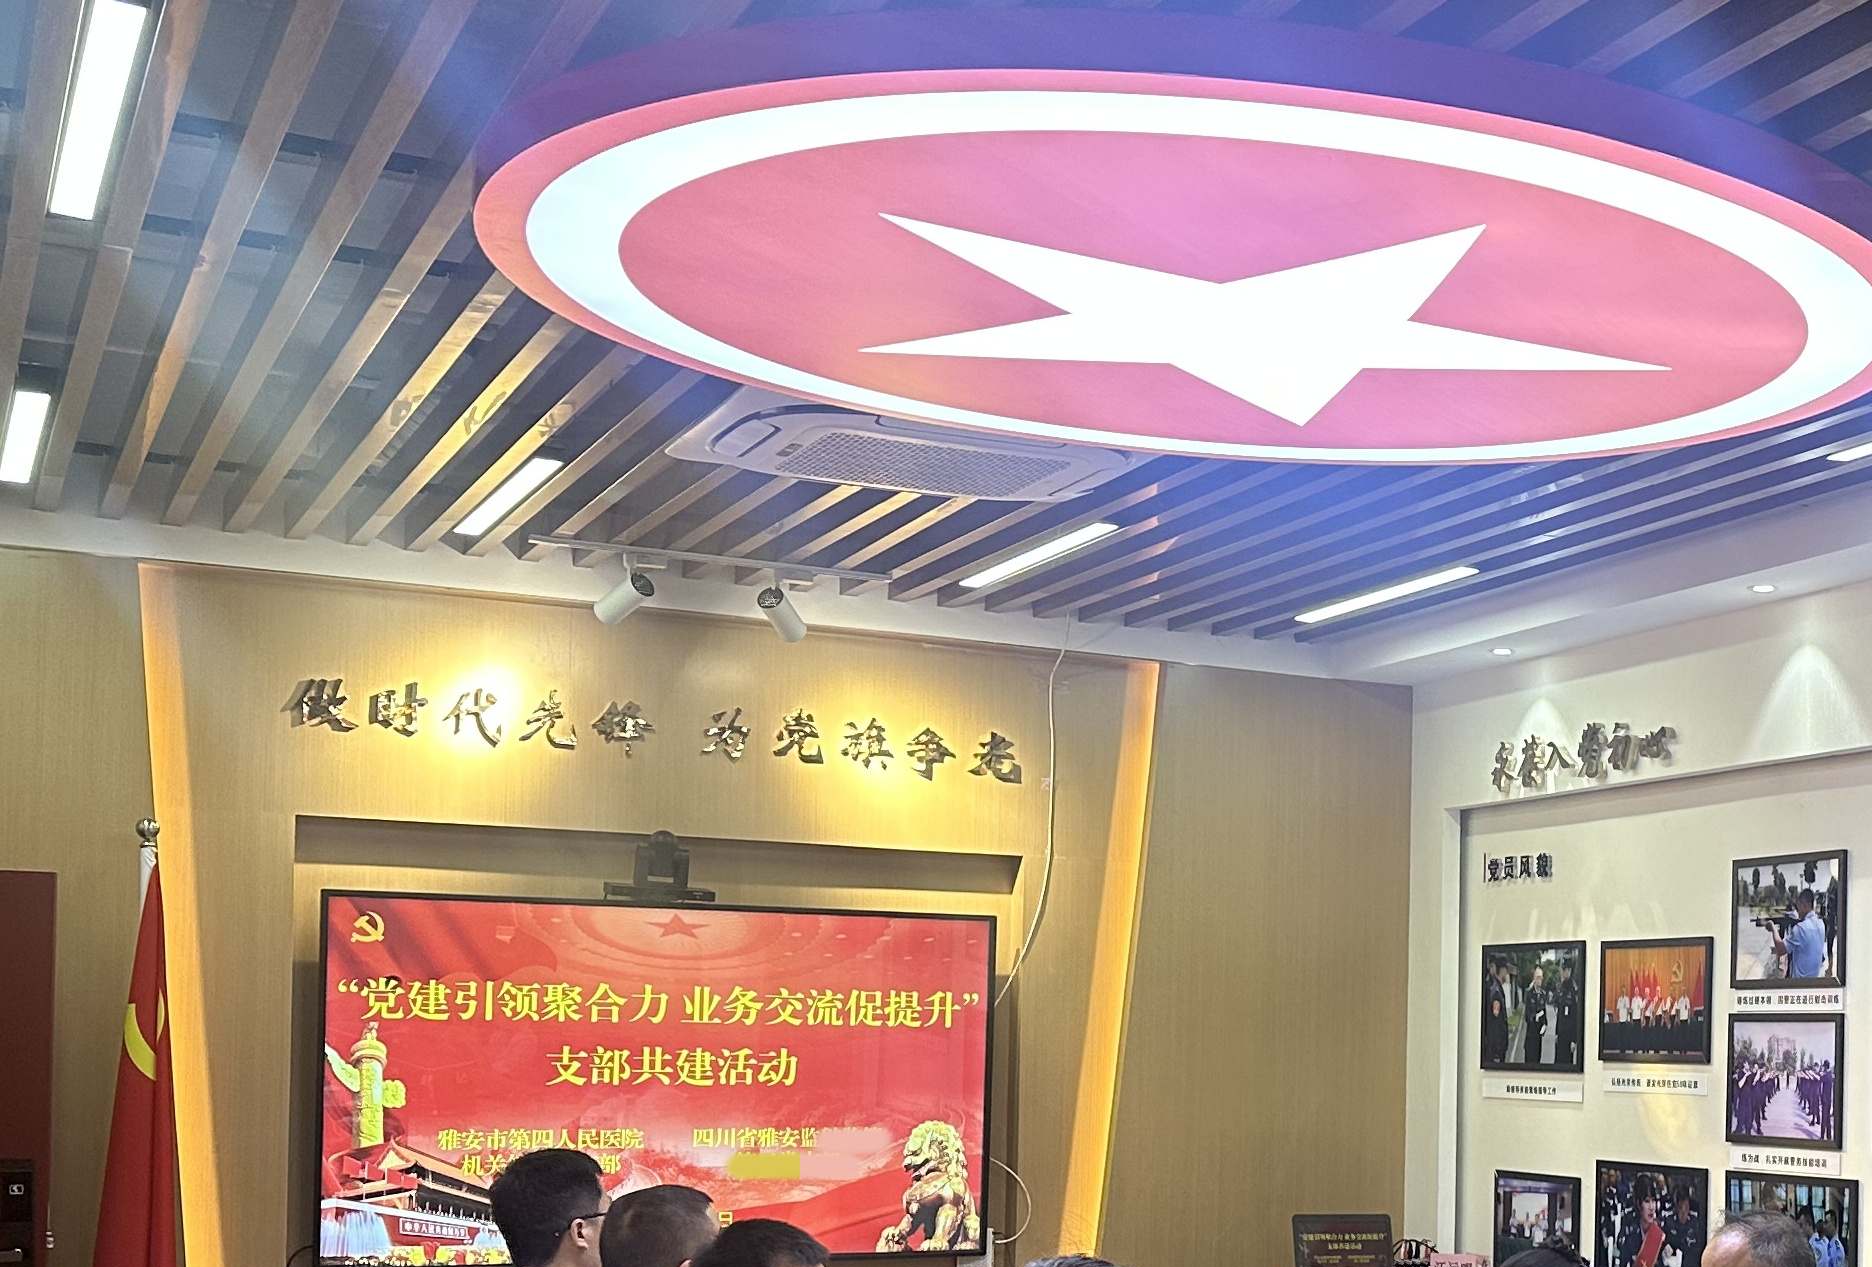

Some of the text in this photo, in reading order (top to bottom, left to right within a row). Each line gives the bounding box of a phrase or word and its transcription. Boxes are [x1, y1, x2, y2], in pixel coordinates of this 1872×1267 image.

[1487, 853, 1552, 883] 党员风貌
[337, 976, 978, 1029] “党建引领聚合力 业务交流促提升”
[546, 1046, 799, 1087] 支部共建活动
[438, 1128, 644, 1151] 雅安市第四人民医院
